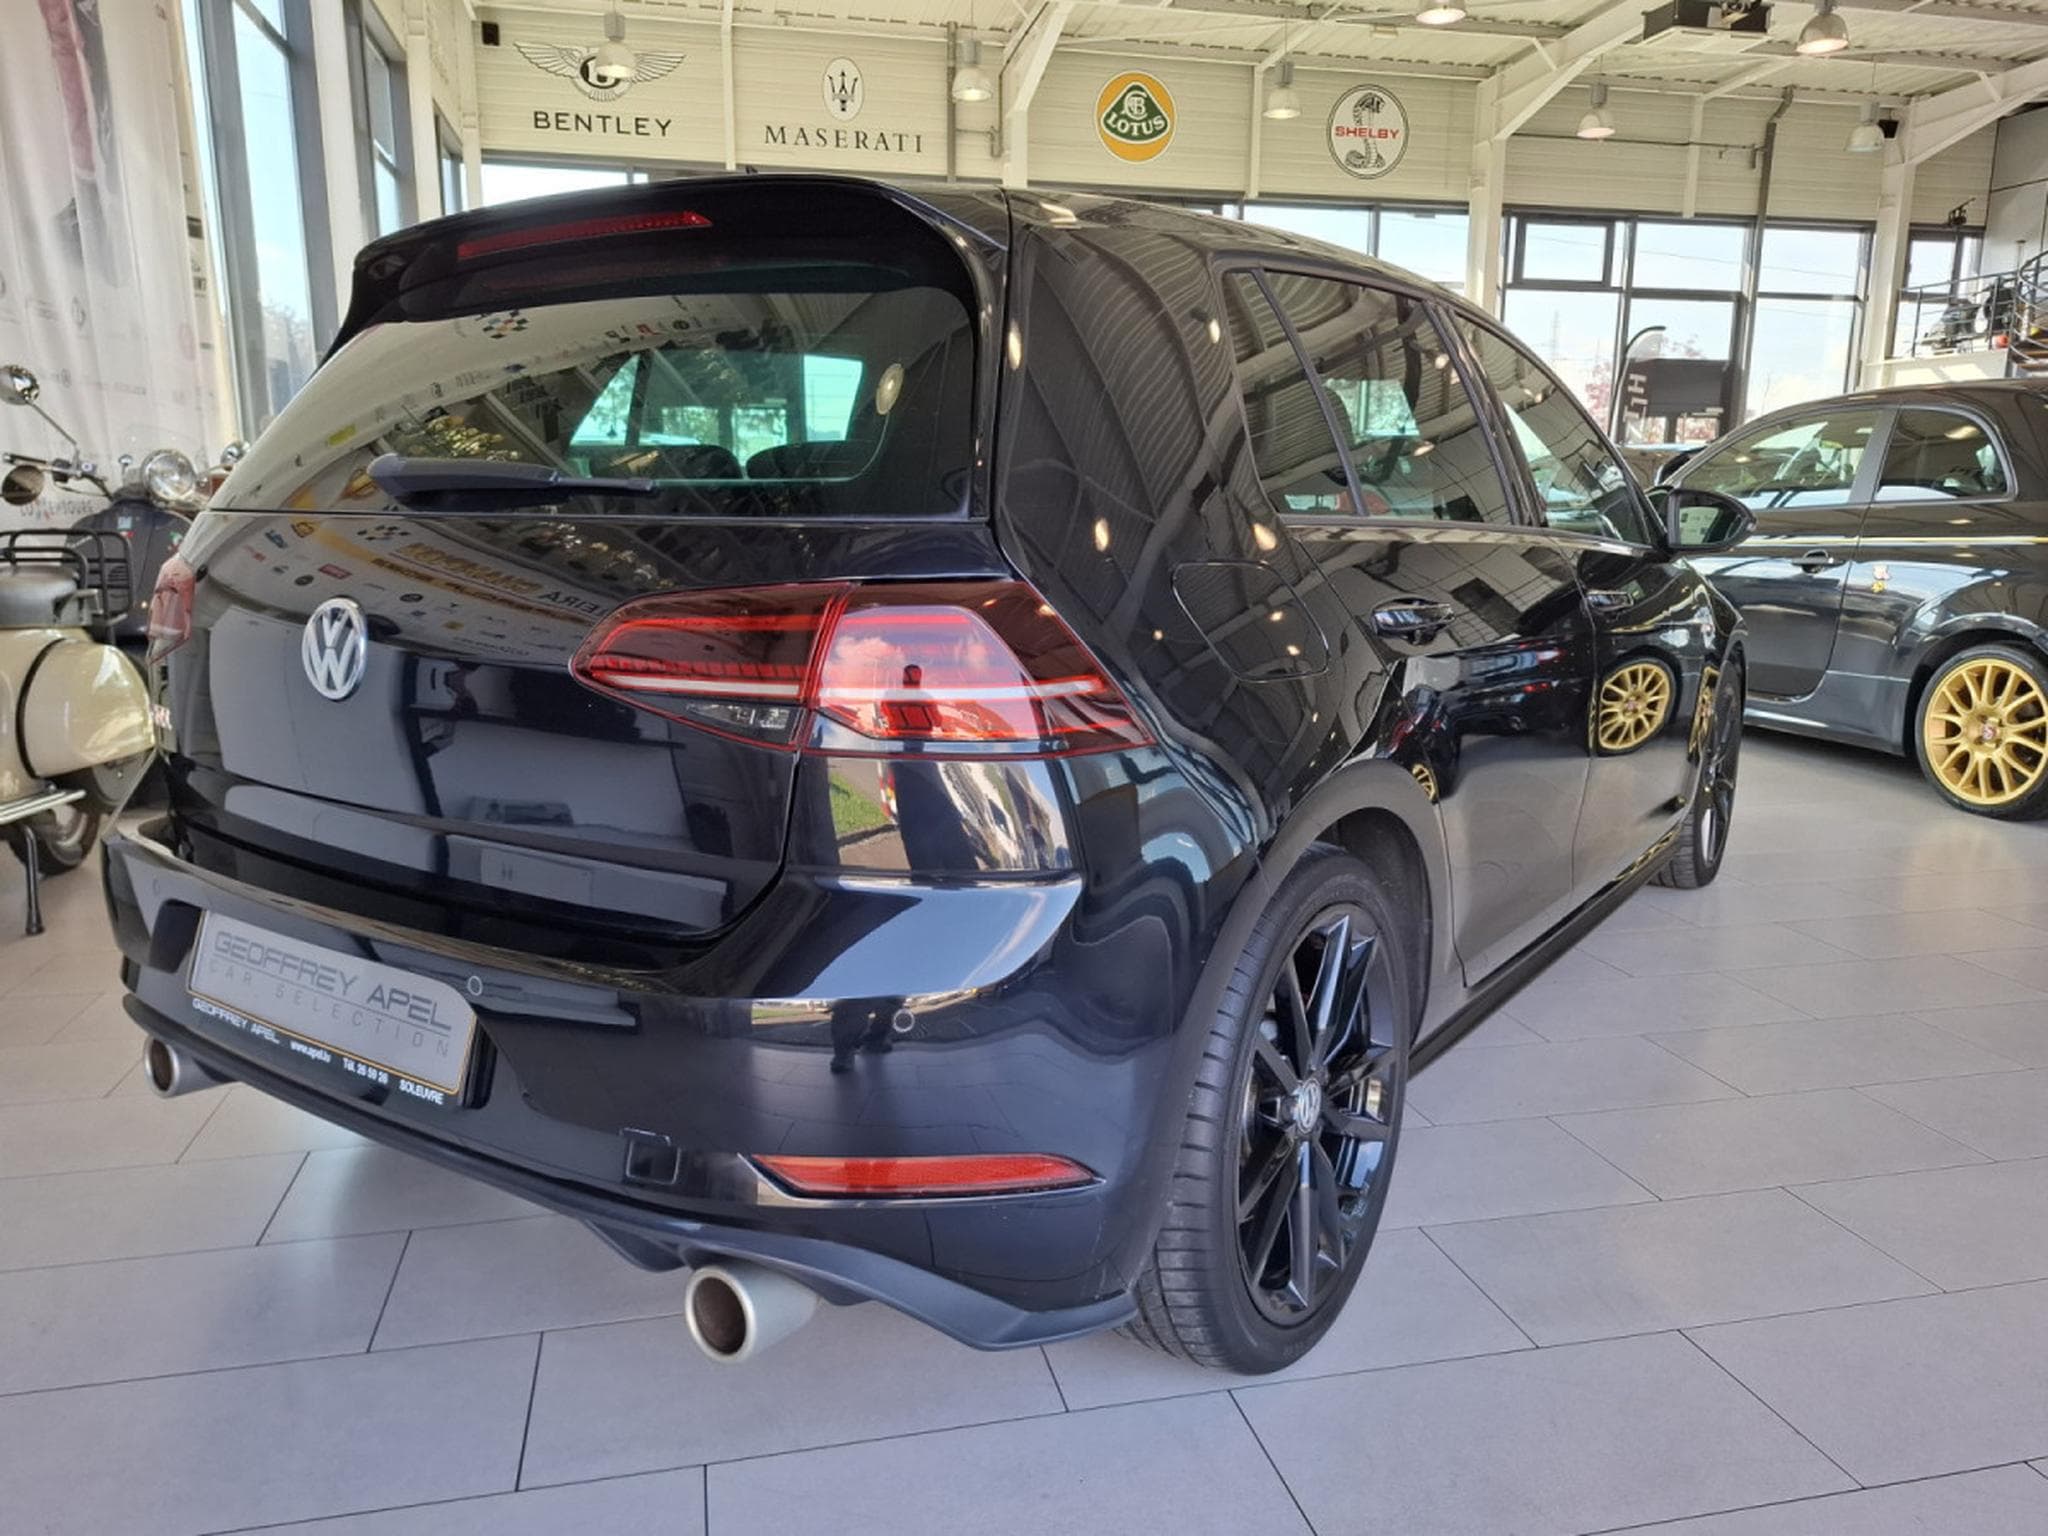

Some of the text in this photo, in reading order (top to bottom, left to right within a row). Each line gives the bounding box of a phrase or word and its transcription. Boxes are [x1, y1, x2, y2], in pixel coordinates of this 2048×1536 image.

[533, 110, 672, 138] BENTLEY
[1106, 111, 1166, 136] LOTUS
[1335, 125, 1400, 140] SHELBY
[764, 124, 923, 154] MASERATI
[214, 930, 452, 1031] GEOFFREY APEL
[192, 998, 248, 1030] GEOFFREY
[208, 960, 450, 1058] CAR SELECTION
